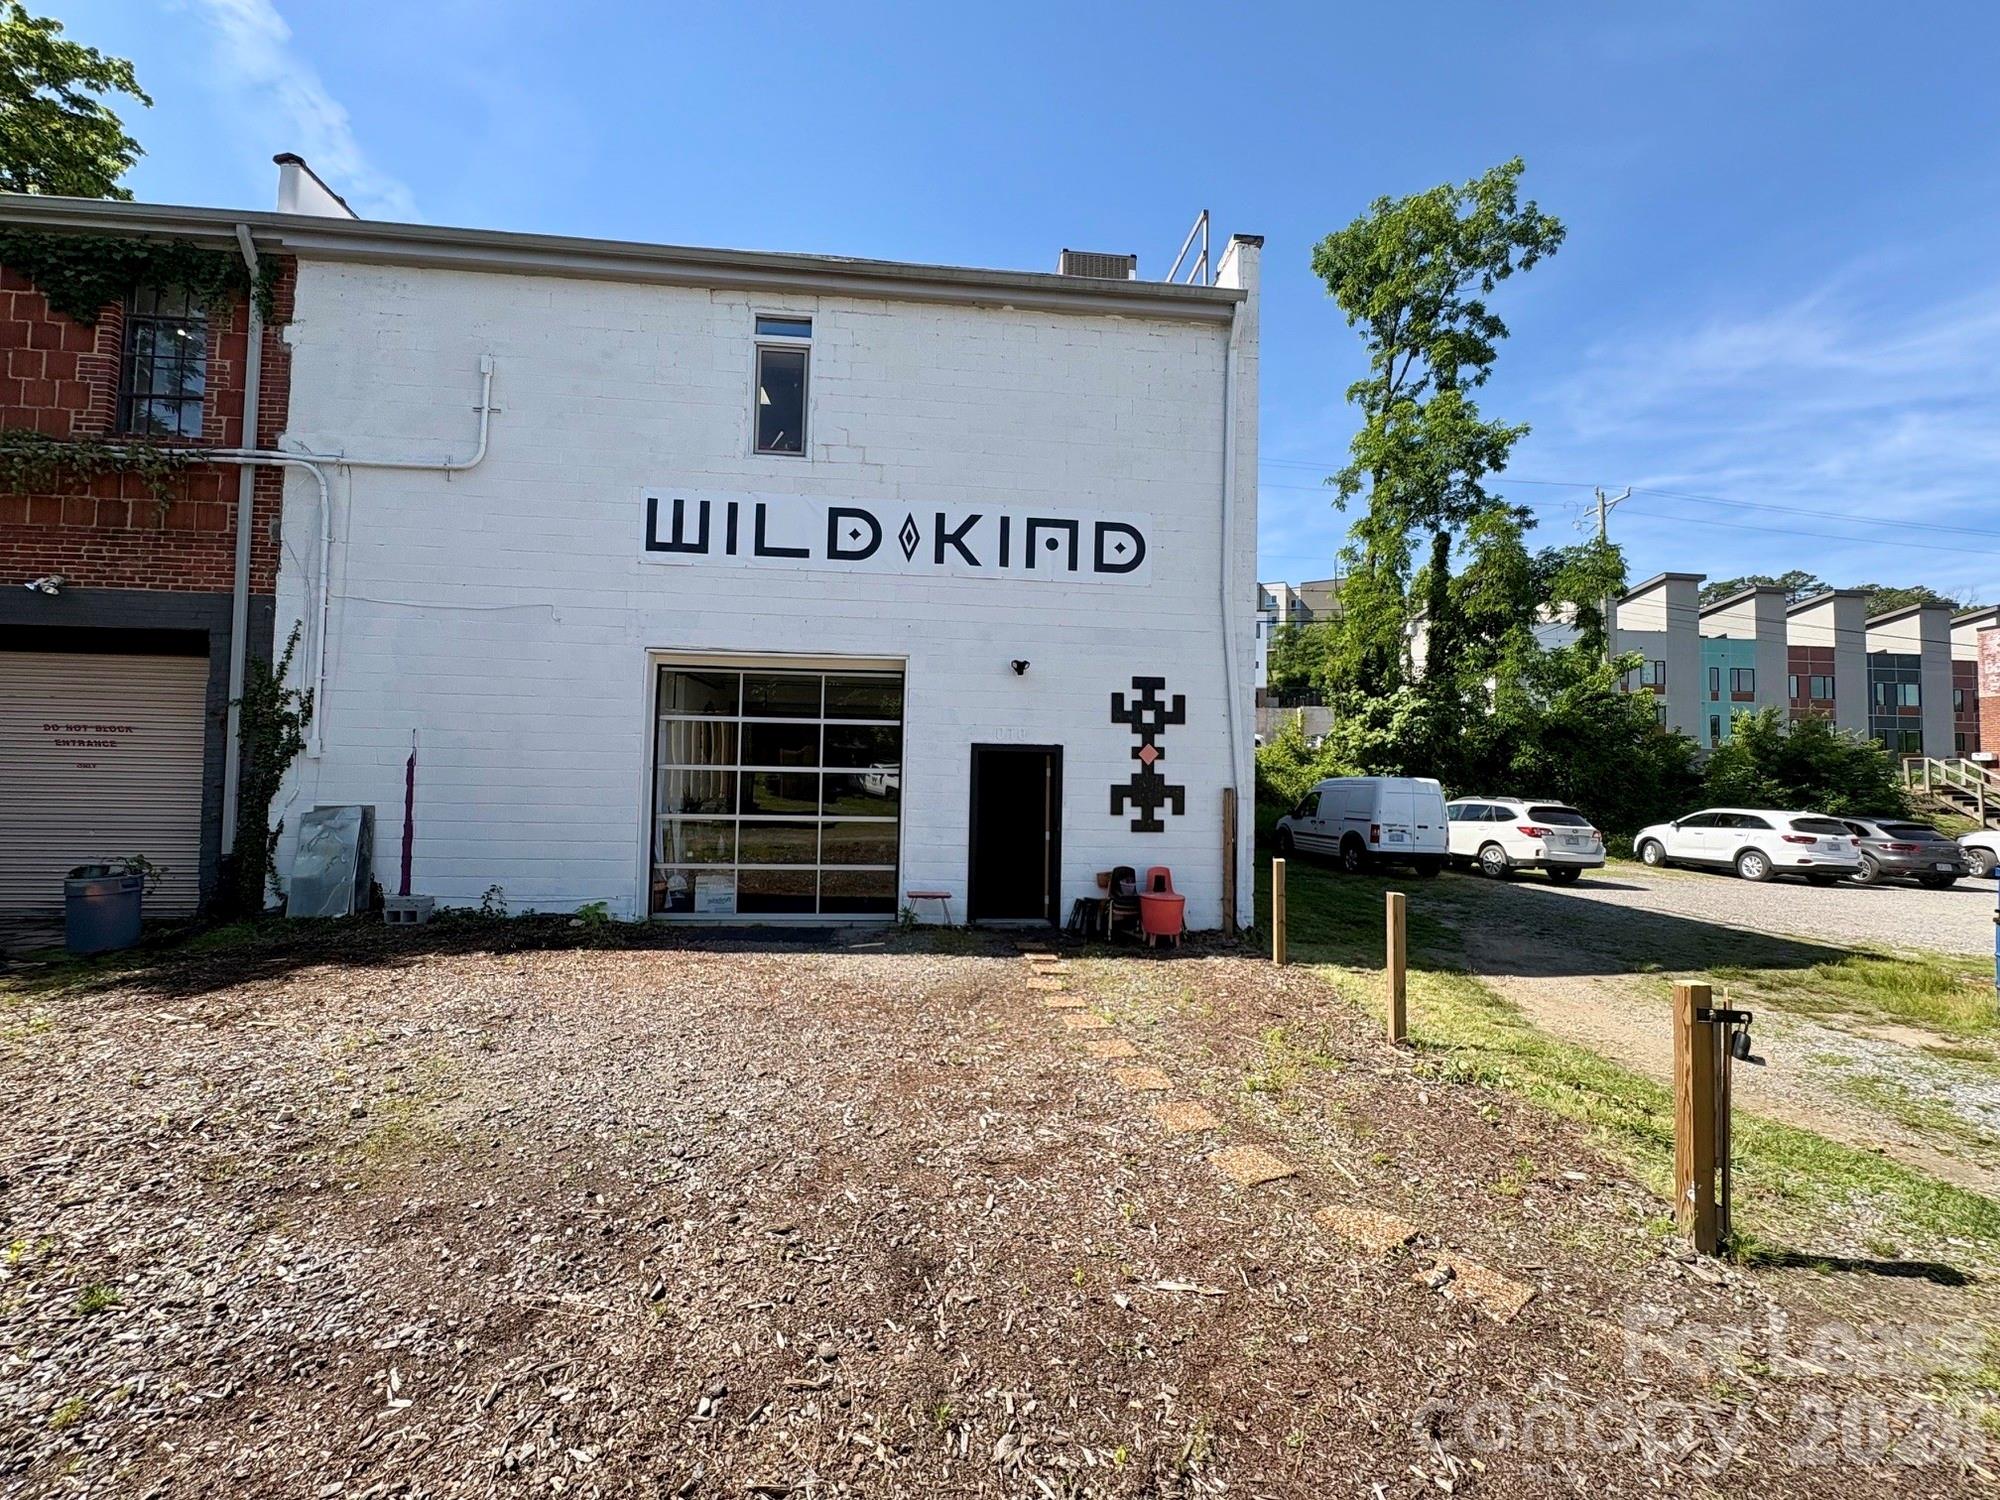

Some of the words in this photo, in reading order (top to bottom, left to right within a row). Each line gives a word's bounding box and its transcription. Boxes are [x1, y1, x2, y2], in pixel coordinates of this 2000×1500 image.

[645, 498, 883, 561] WILD
[934, 512, 1147, 574] KIND
[43, 724, 60, 732] DO
[66, 724, 89, 732] NOT
[95, 725, 134, 733] BLOCK
[54, 739, 118, 748] ENTRANCE
